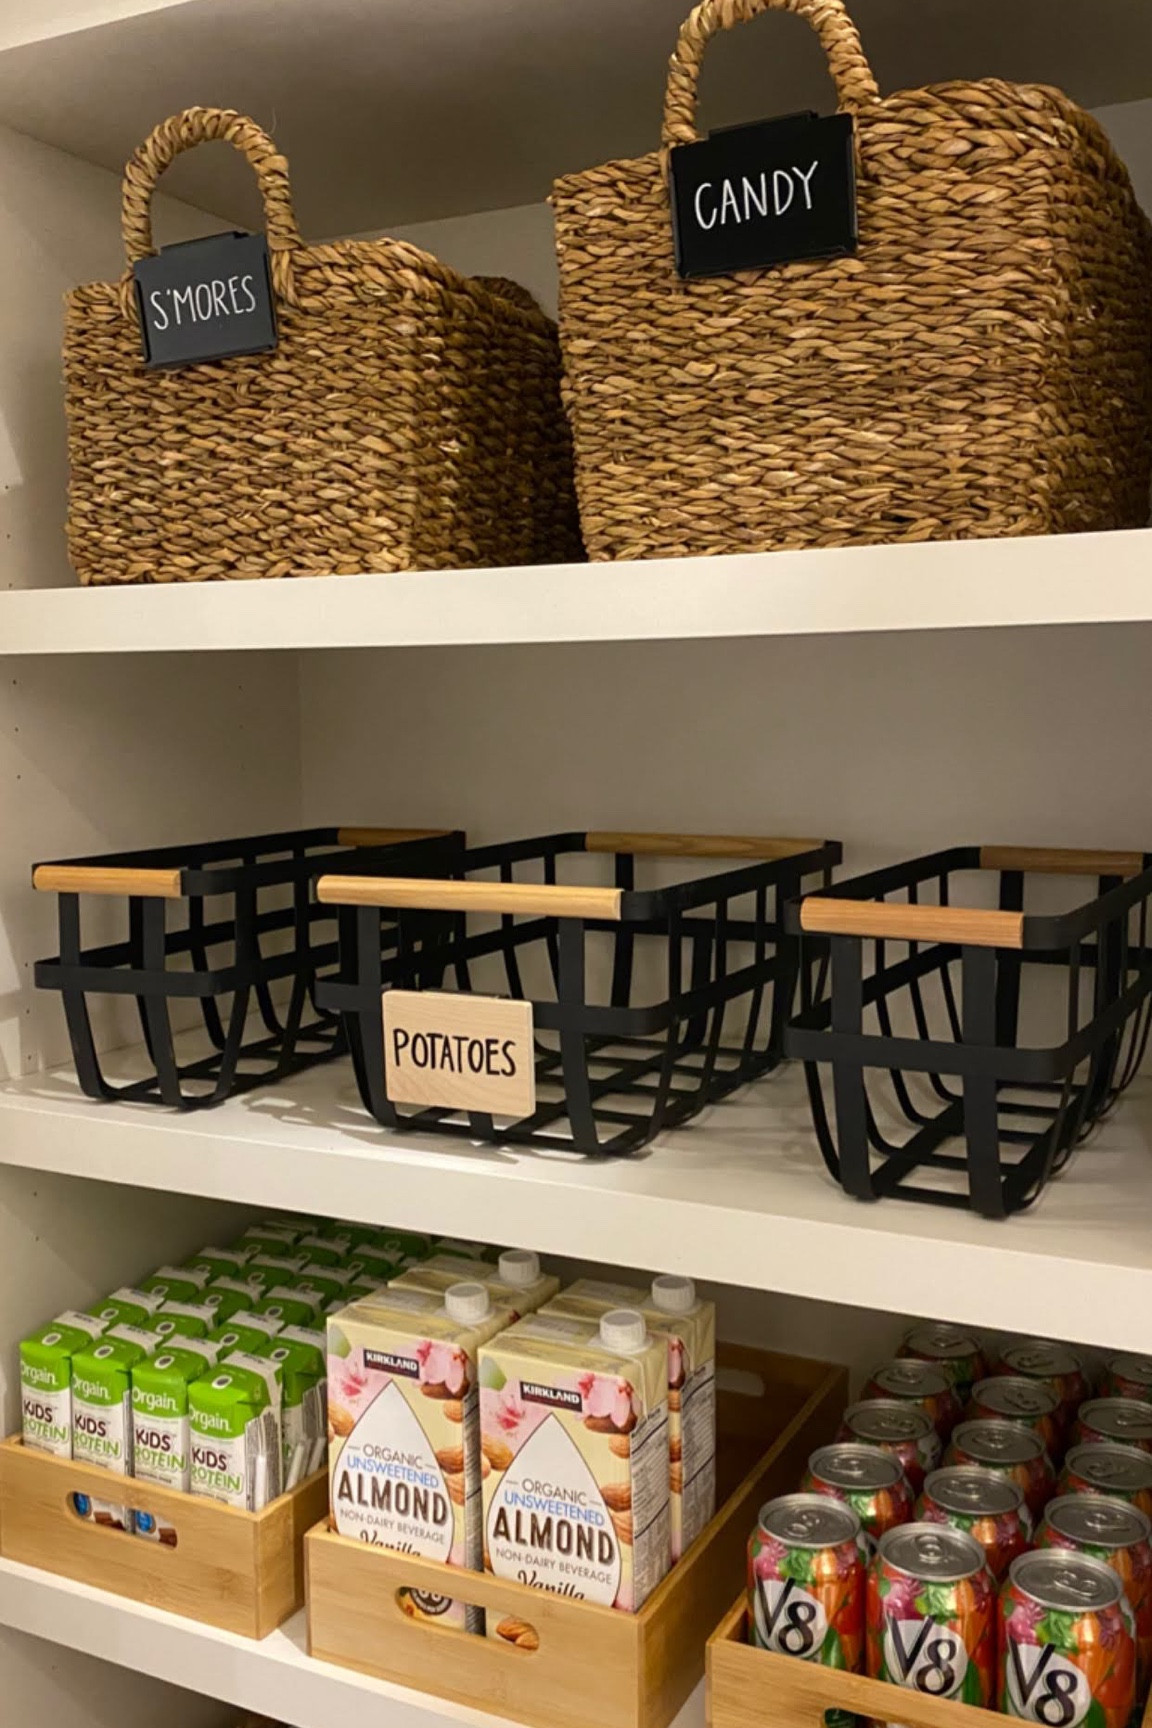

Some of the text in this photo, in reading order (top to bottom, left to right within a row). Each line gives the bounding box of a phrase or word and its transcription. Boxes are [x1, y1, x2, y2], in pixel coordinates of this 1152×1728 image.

[694, 160, 818, 229] CANDY
[150, 275, 256, 330] S'MORES
[393, 1028, 516, 1077] POTATOES
[365, 1351, 419, 1373] KIRKLAND
[523, 1383, 581, 1405] KIRKLAND
[347, 1455, 439, 1488] UNSWEETENED
[363, 1443, 423, 1470] ORGANIC
[338, 1470, 448, 1526] ALMOND
[504, 1490, 604, 1527] UNSWEETENED
[522, 1478, 587, 1507] ORGANIC
[340, 1509, 446, 1545] NON-DAIRY BEVERAGE
[493, 1506, 615, 1567] ALMOND
[496, 1547, 613, 1585] NON-DAIRY BEVERAGE
[756, 1575, 816, 1655] V8
[885, 1613, 957, 1695] V8
[1010, 1636, 1078, 1728] V8
